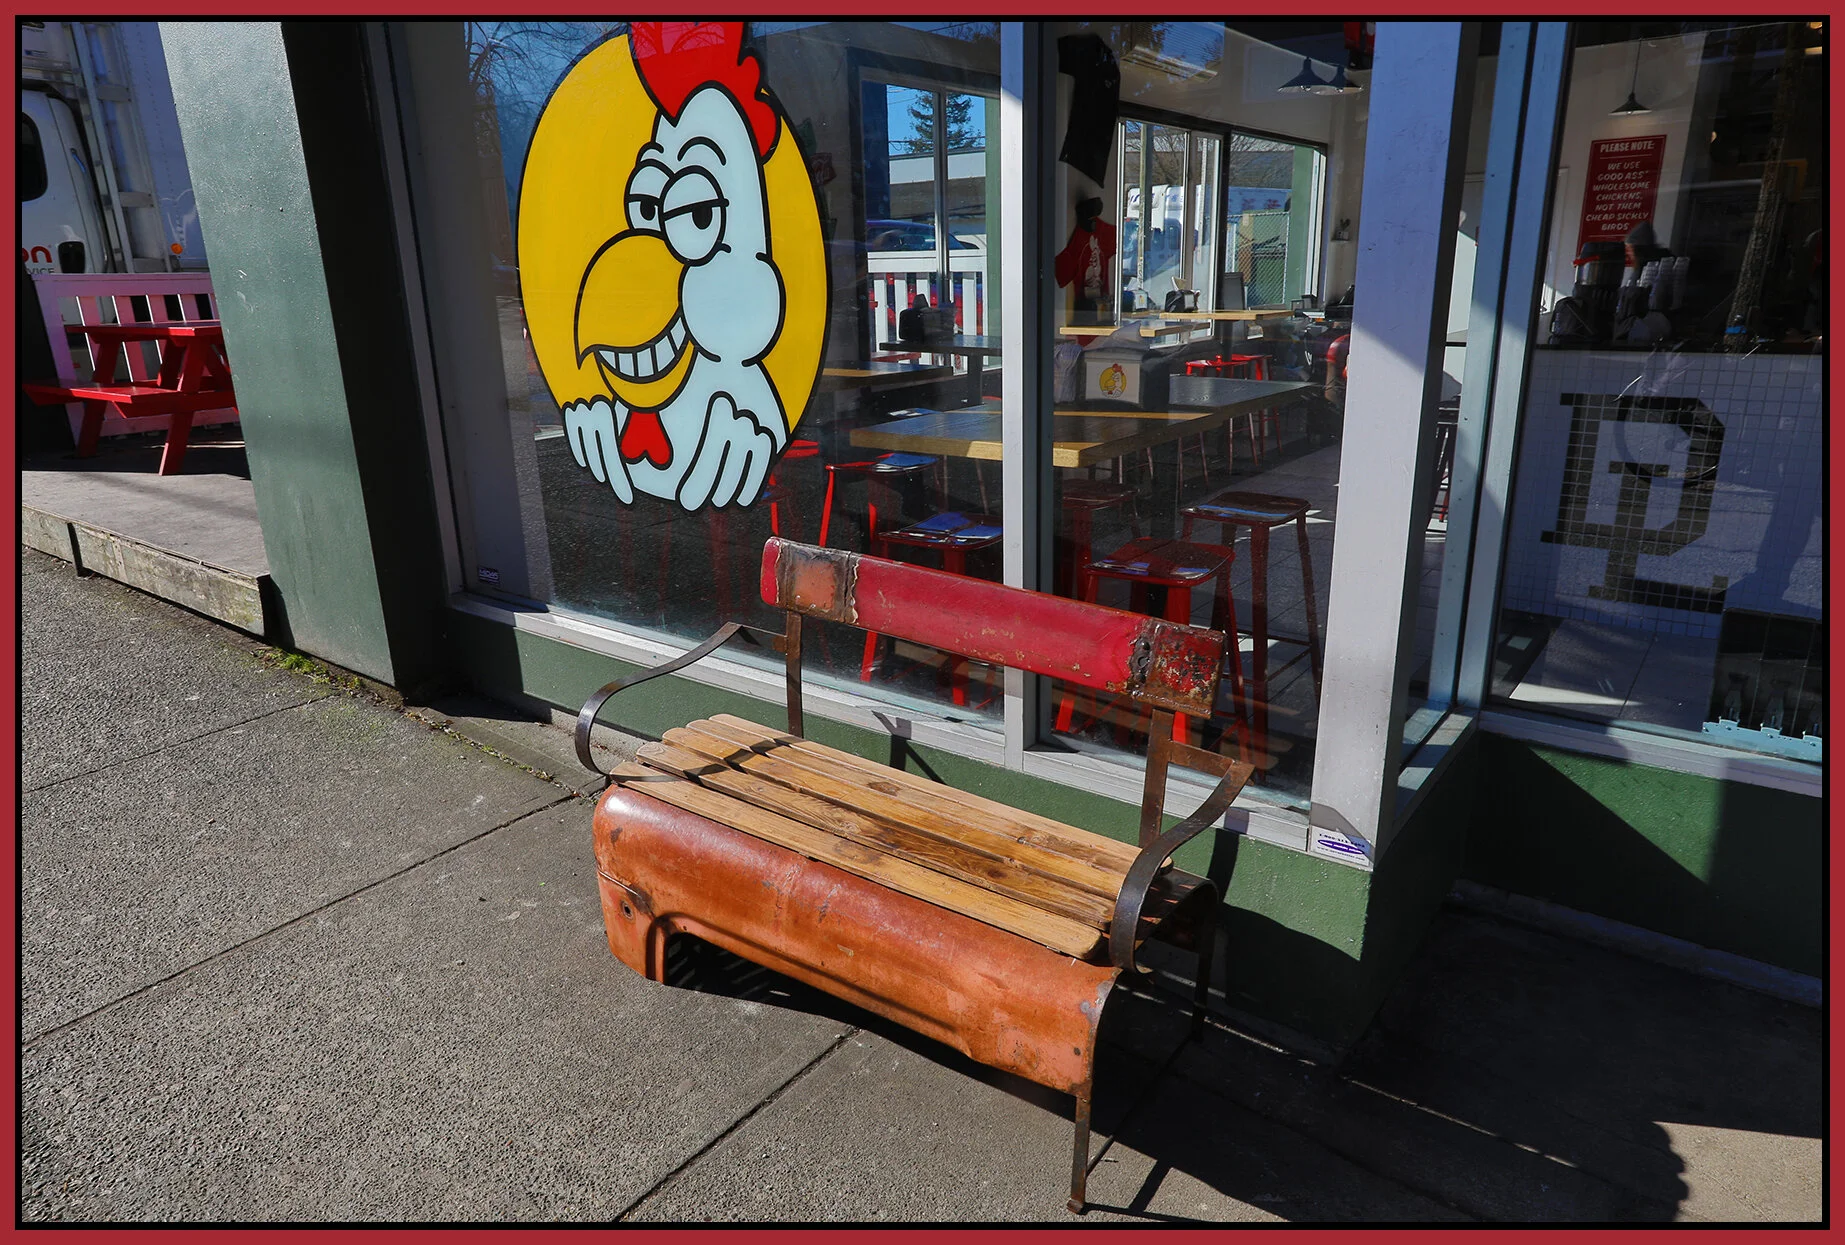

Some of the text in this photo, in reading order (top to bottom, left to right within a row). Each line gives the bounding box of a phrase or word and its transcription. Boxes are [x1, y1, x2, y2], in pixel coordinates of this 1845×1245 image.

[1600, 142, 1630, 153] PLEASE
[1607, 160, 1640, 171] WE USE
[1597, 172, 1623, 181] GOOD
[1593, 181, 1650, 191] WHOLESOME
[1595, 202, 1642, 212] NOT THEM
[1586, 212, 1649, 222] CHEAP SICKLY
